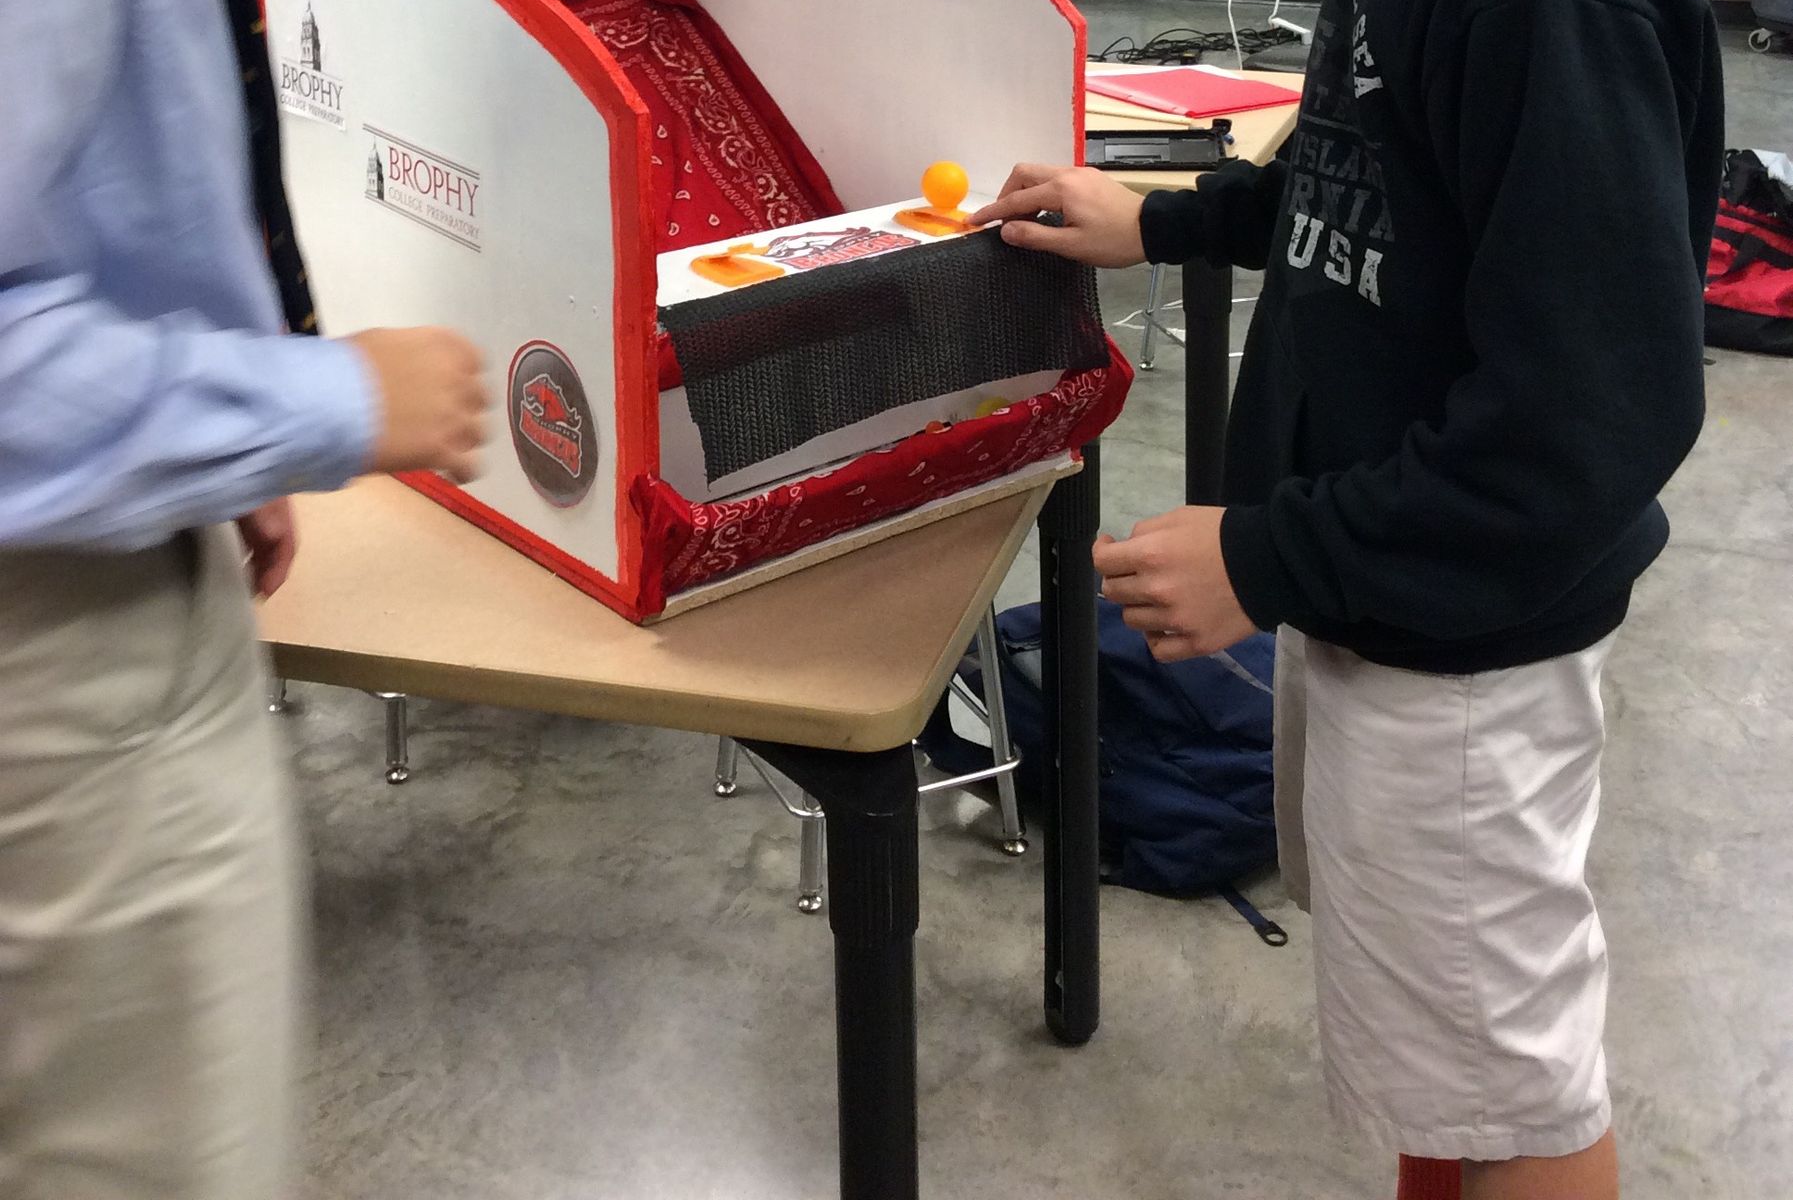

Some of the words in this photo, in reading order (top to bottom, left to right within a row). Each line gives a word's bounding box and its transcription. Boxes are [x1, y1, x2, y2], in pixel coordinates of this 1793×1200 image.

[281, 63, 343, 111] BROPHY
[388, 146, 479, 217] BROPHY
[388, 186, 423, 213] COLLEGE
[426, 204, 480, 239] PREPARATORY
[1287, 211, 1383, 309] USA
